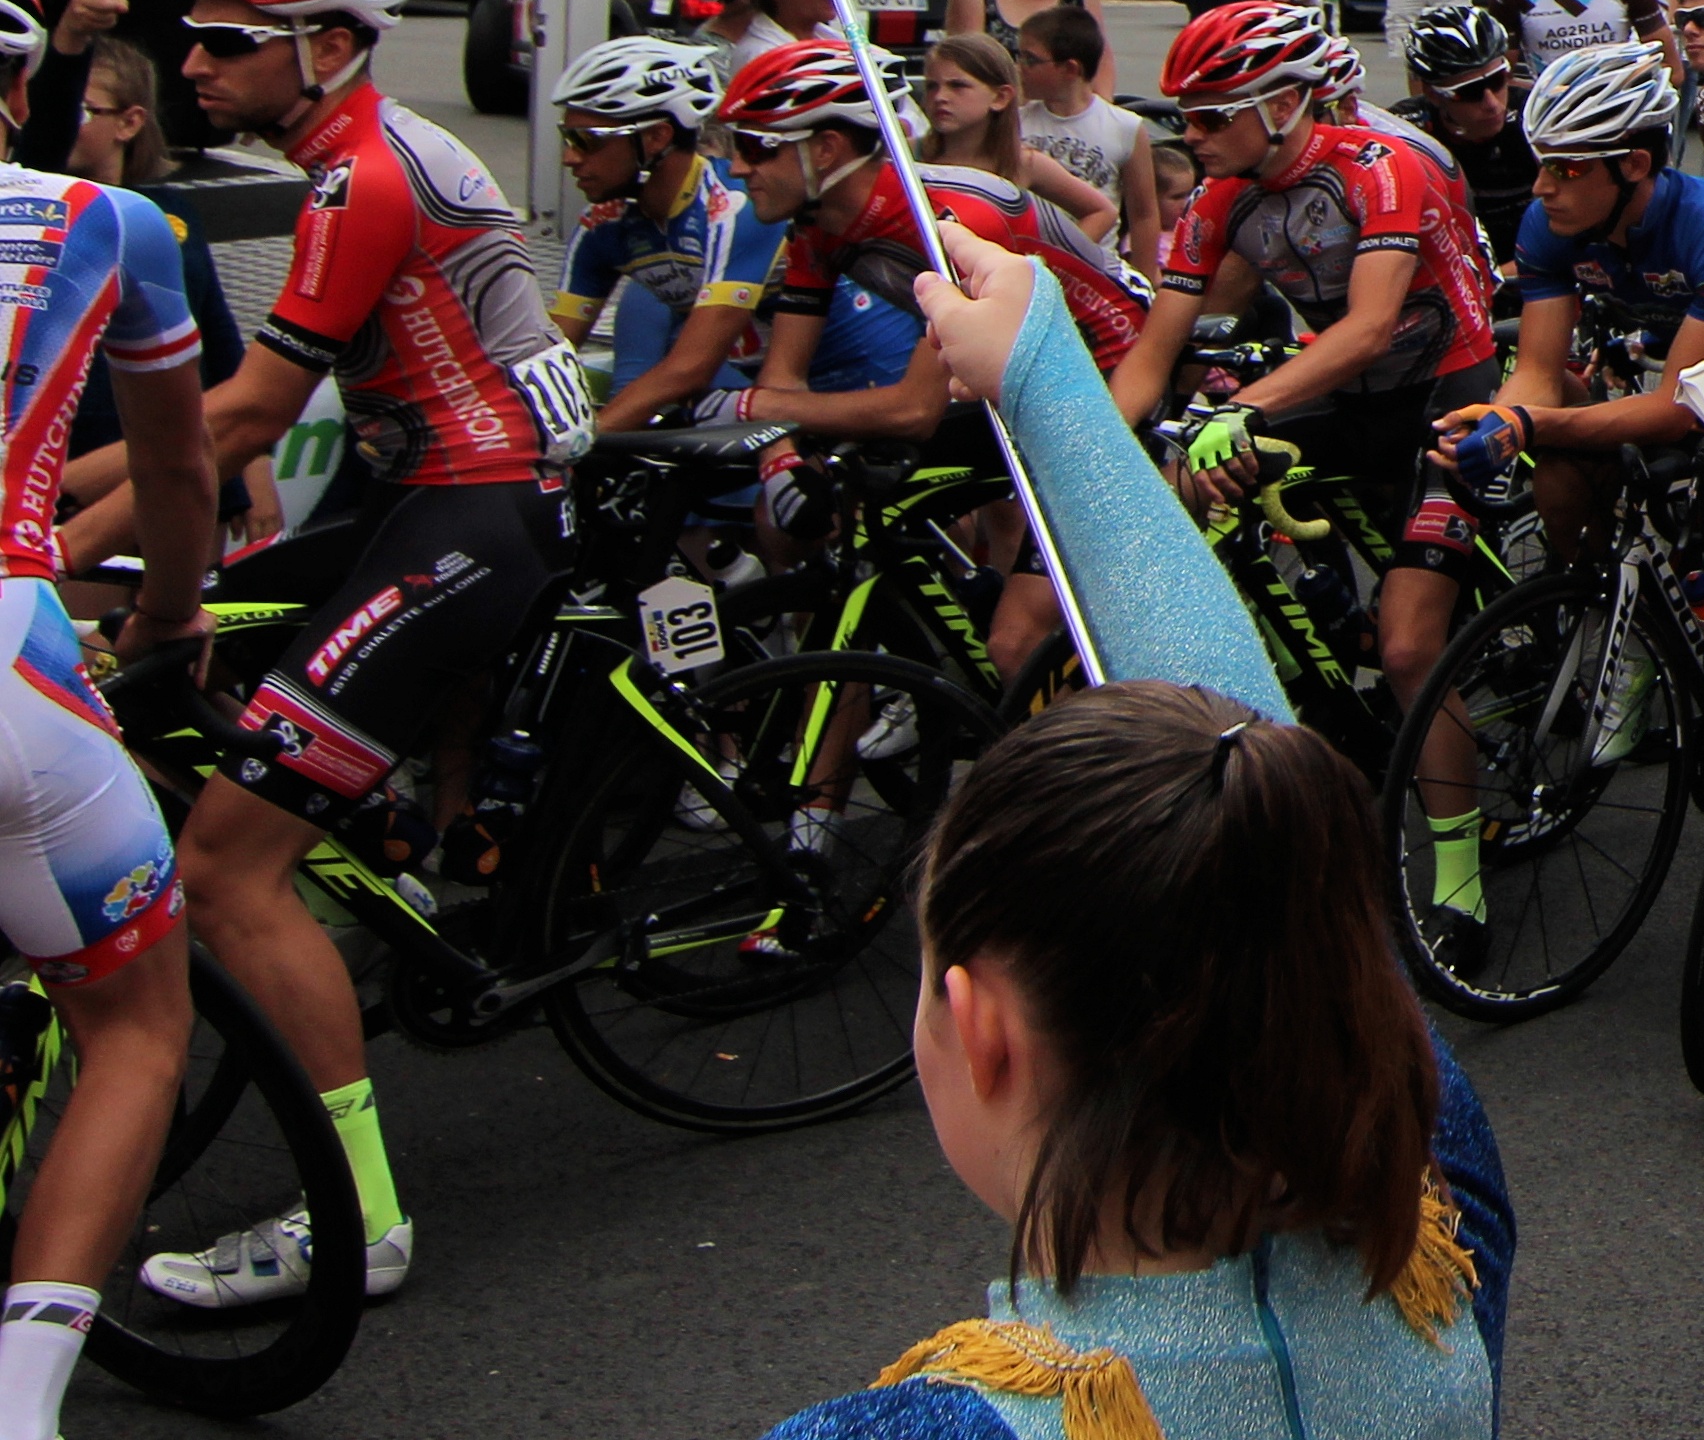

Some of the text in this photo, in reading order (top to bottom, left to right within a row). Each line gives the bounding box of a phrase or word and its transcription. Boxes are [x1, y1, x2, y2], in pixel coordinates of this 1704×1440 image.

[1538, 31, 1616, 50] MONDIALE
[1546, 21, 1612, 39] AG2R LA
[307, 586, 402, 679] TIME
[329, 661, 360, 698] 45120
[357, 606, 422, 661] CHALETTE
[447, 566, 493, 602] LOING
[668, 600, 718, 661] 103
[1264, 579, 1349, 689] TIME
